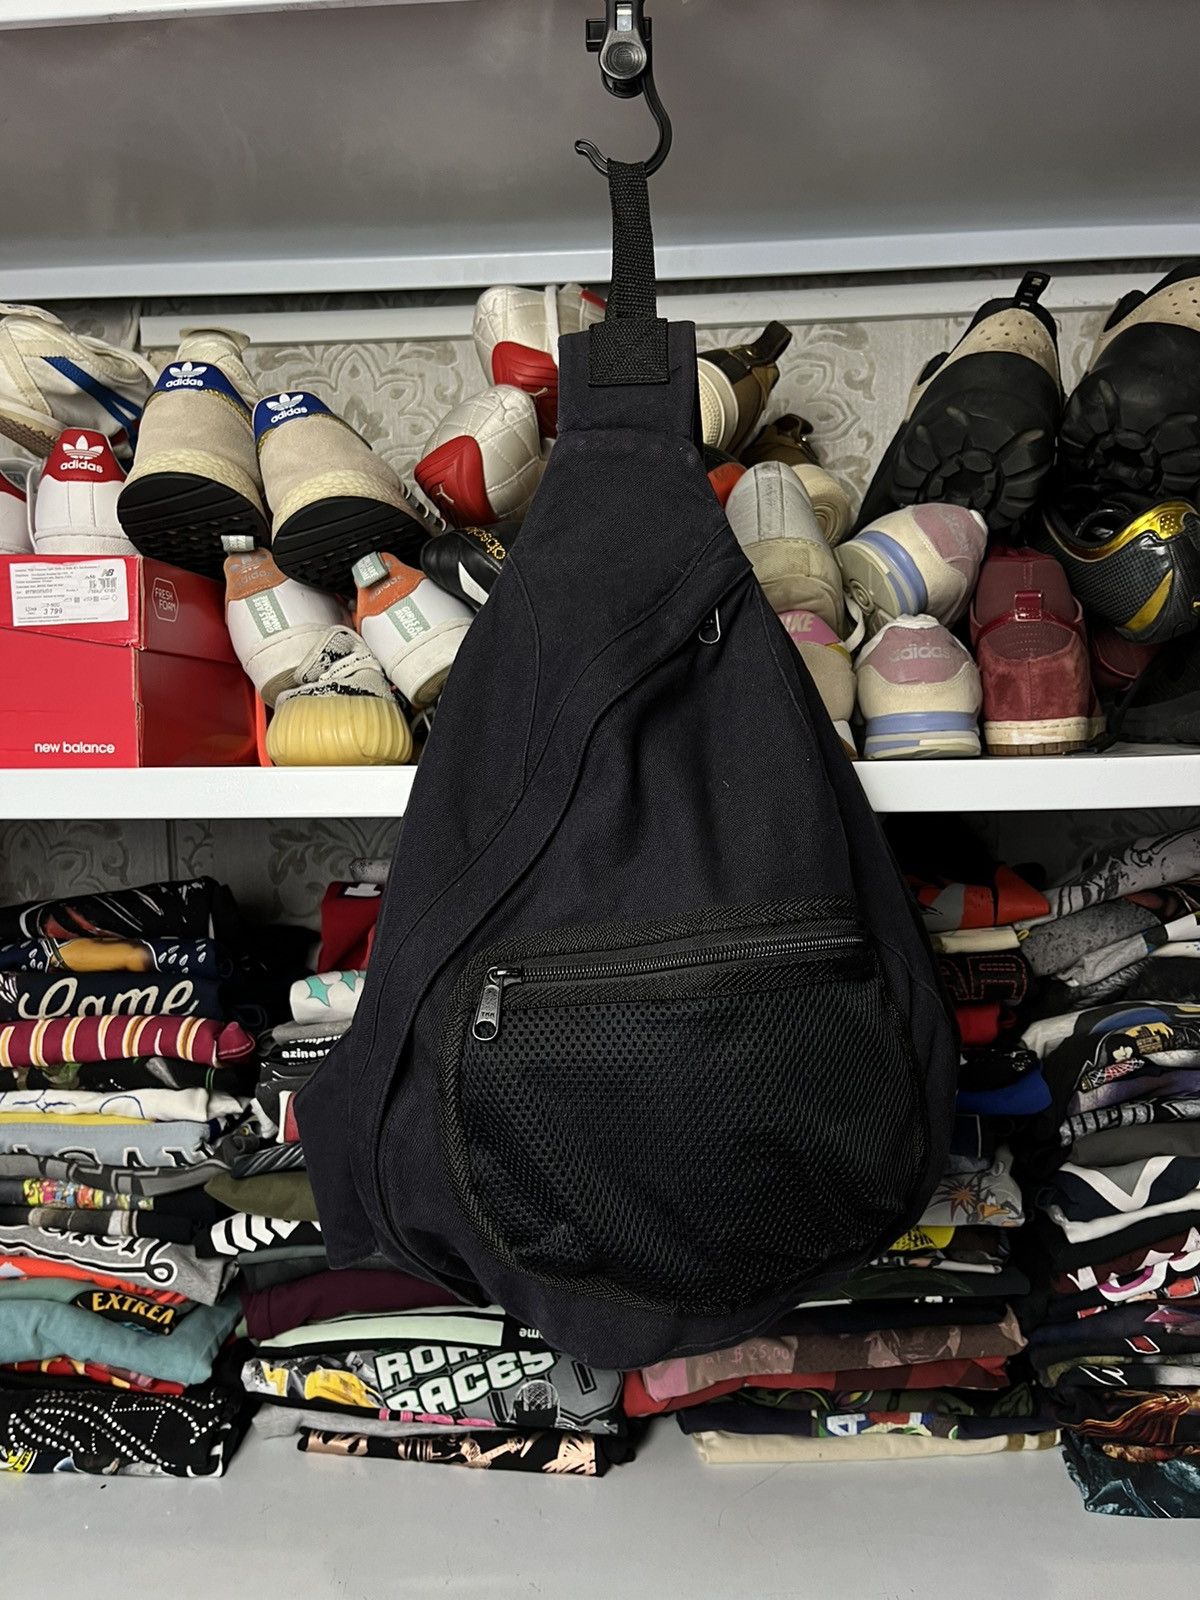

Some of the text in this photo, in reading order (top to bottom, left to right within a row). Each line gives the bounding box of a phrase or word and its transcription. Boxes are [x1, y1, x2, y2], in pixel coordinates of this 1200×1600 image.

[165, 377, 204, 388] adidas
[271, 406, 308, 423] adidas
[60, 461, 103, 474] adidas
[154, 587, 174, 600] FRESH
[159, 599, 176, 611] FOAM
[34, 741, 115, 754] new balance
